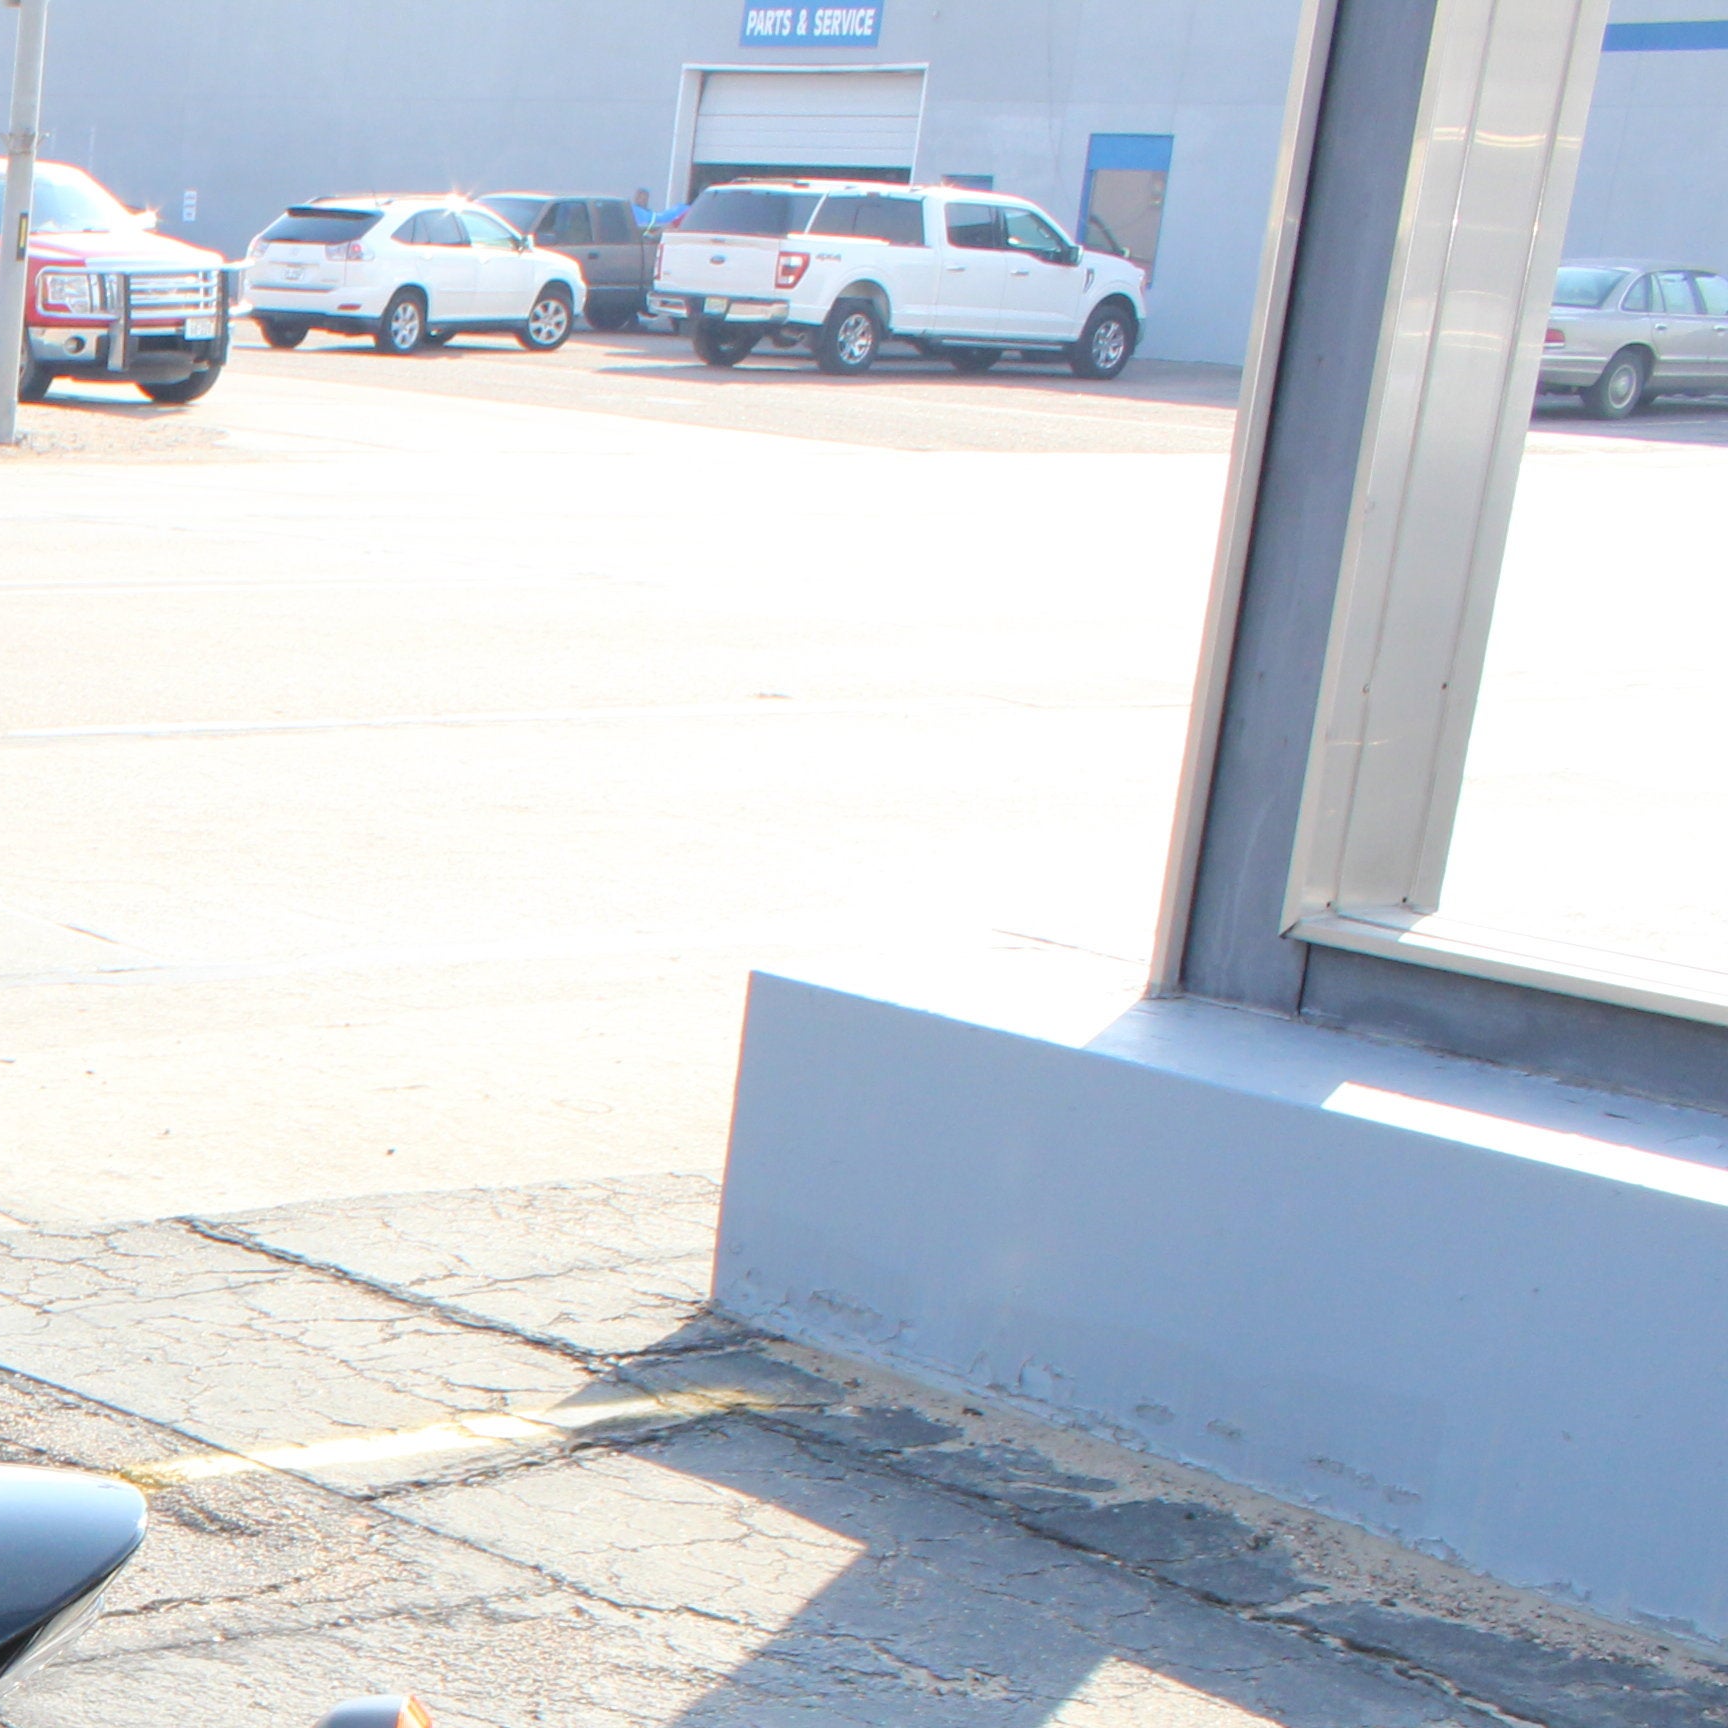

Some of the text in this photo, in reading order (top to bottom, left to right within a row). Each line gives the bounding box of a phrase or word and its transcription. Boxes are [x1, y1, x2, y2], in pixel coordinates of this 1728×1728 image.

[746, 8, 876, 36] PARTS & SERVICE
